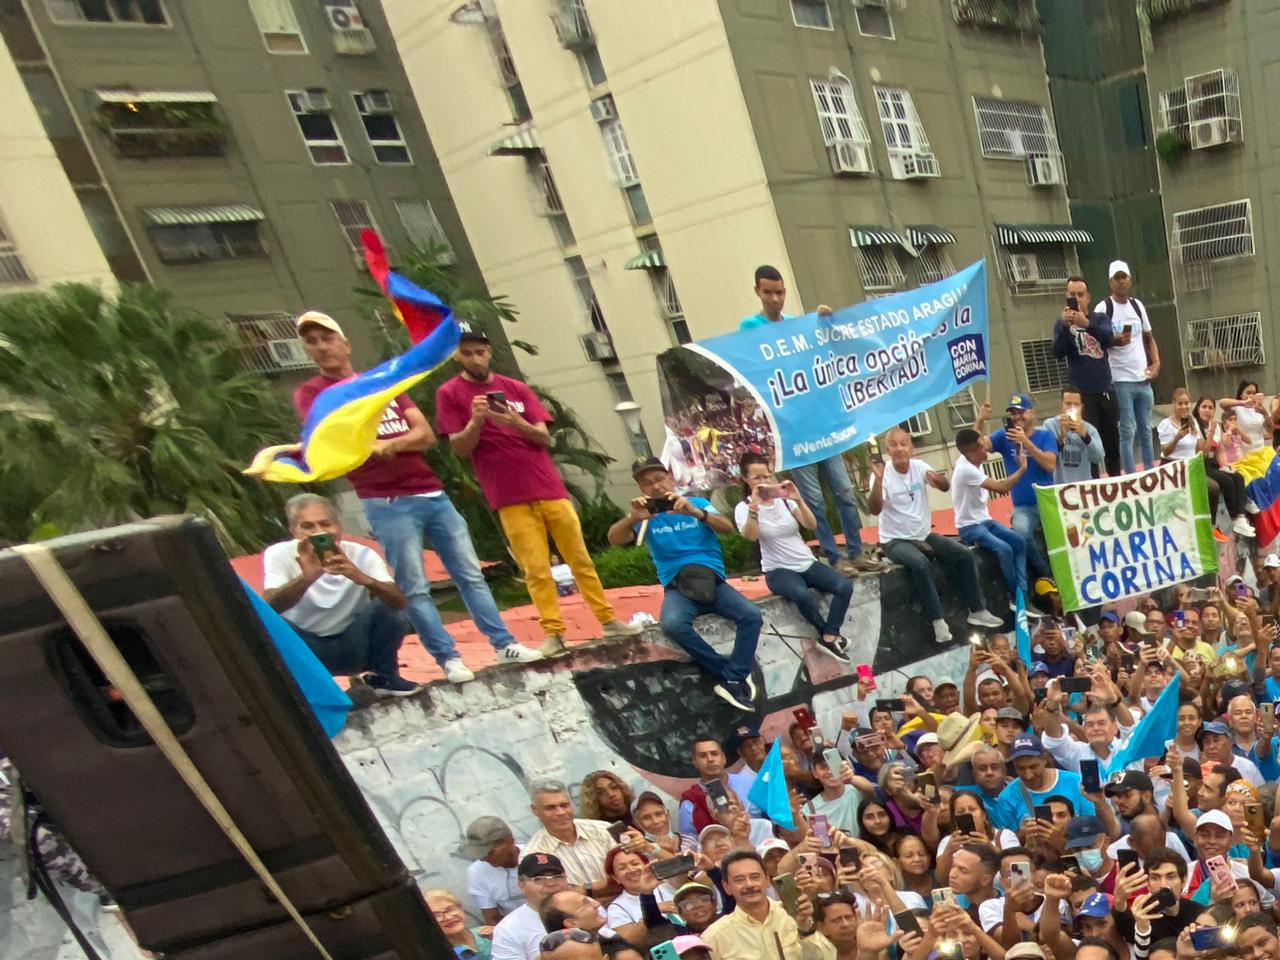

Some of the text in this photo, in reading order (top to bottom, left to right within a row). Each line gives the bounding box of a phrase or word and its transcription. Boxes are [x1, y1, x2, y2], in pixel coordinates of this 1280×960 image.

[759, 334, 814, 361] D.E.M.
[815, 323, 859, 346] SUCRE
[858, 310, 910, 336] ESTADO
[768, 369, 809, 408] ¡La
[813, 351, 859, 388] única
[864, 330, 928, 374] opció
[954, 305, 972, 328] la
[950, 339, 977, 357] CON
[838, 350, 928, 412] LIBERTAD!
[955, 361, 986, 380] CORINA
[1093, 497, 1156, 536] CON
[1088, 526, 1179, 573] MARIA
[1080, 552, 1197, 604] CORINA
